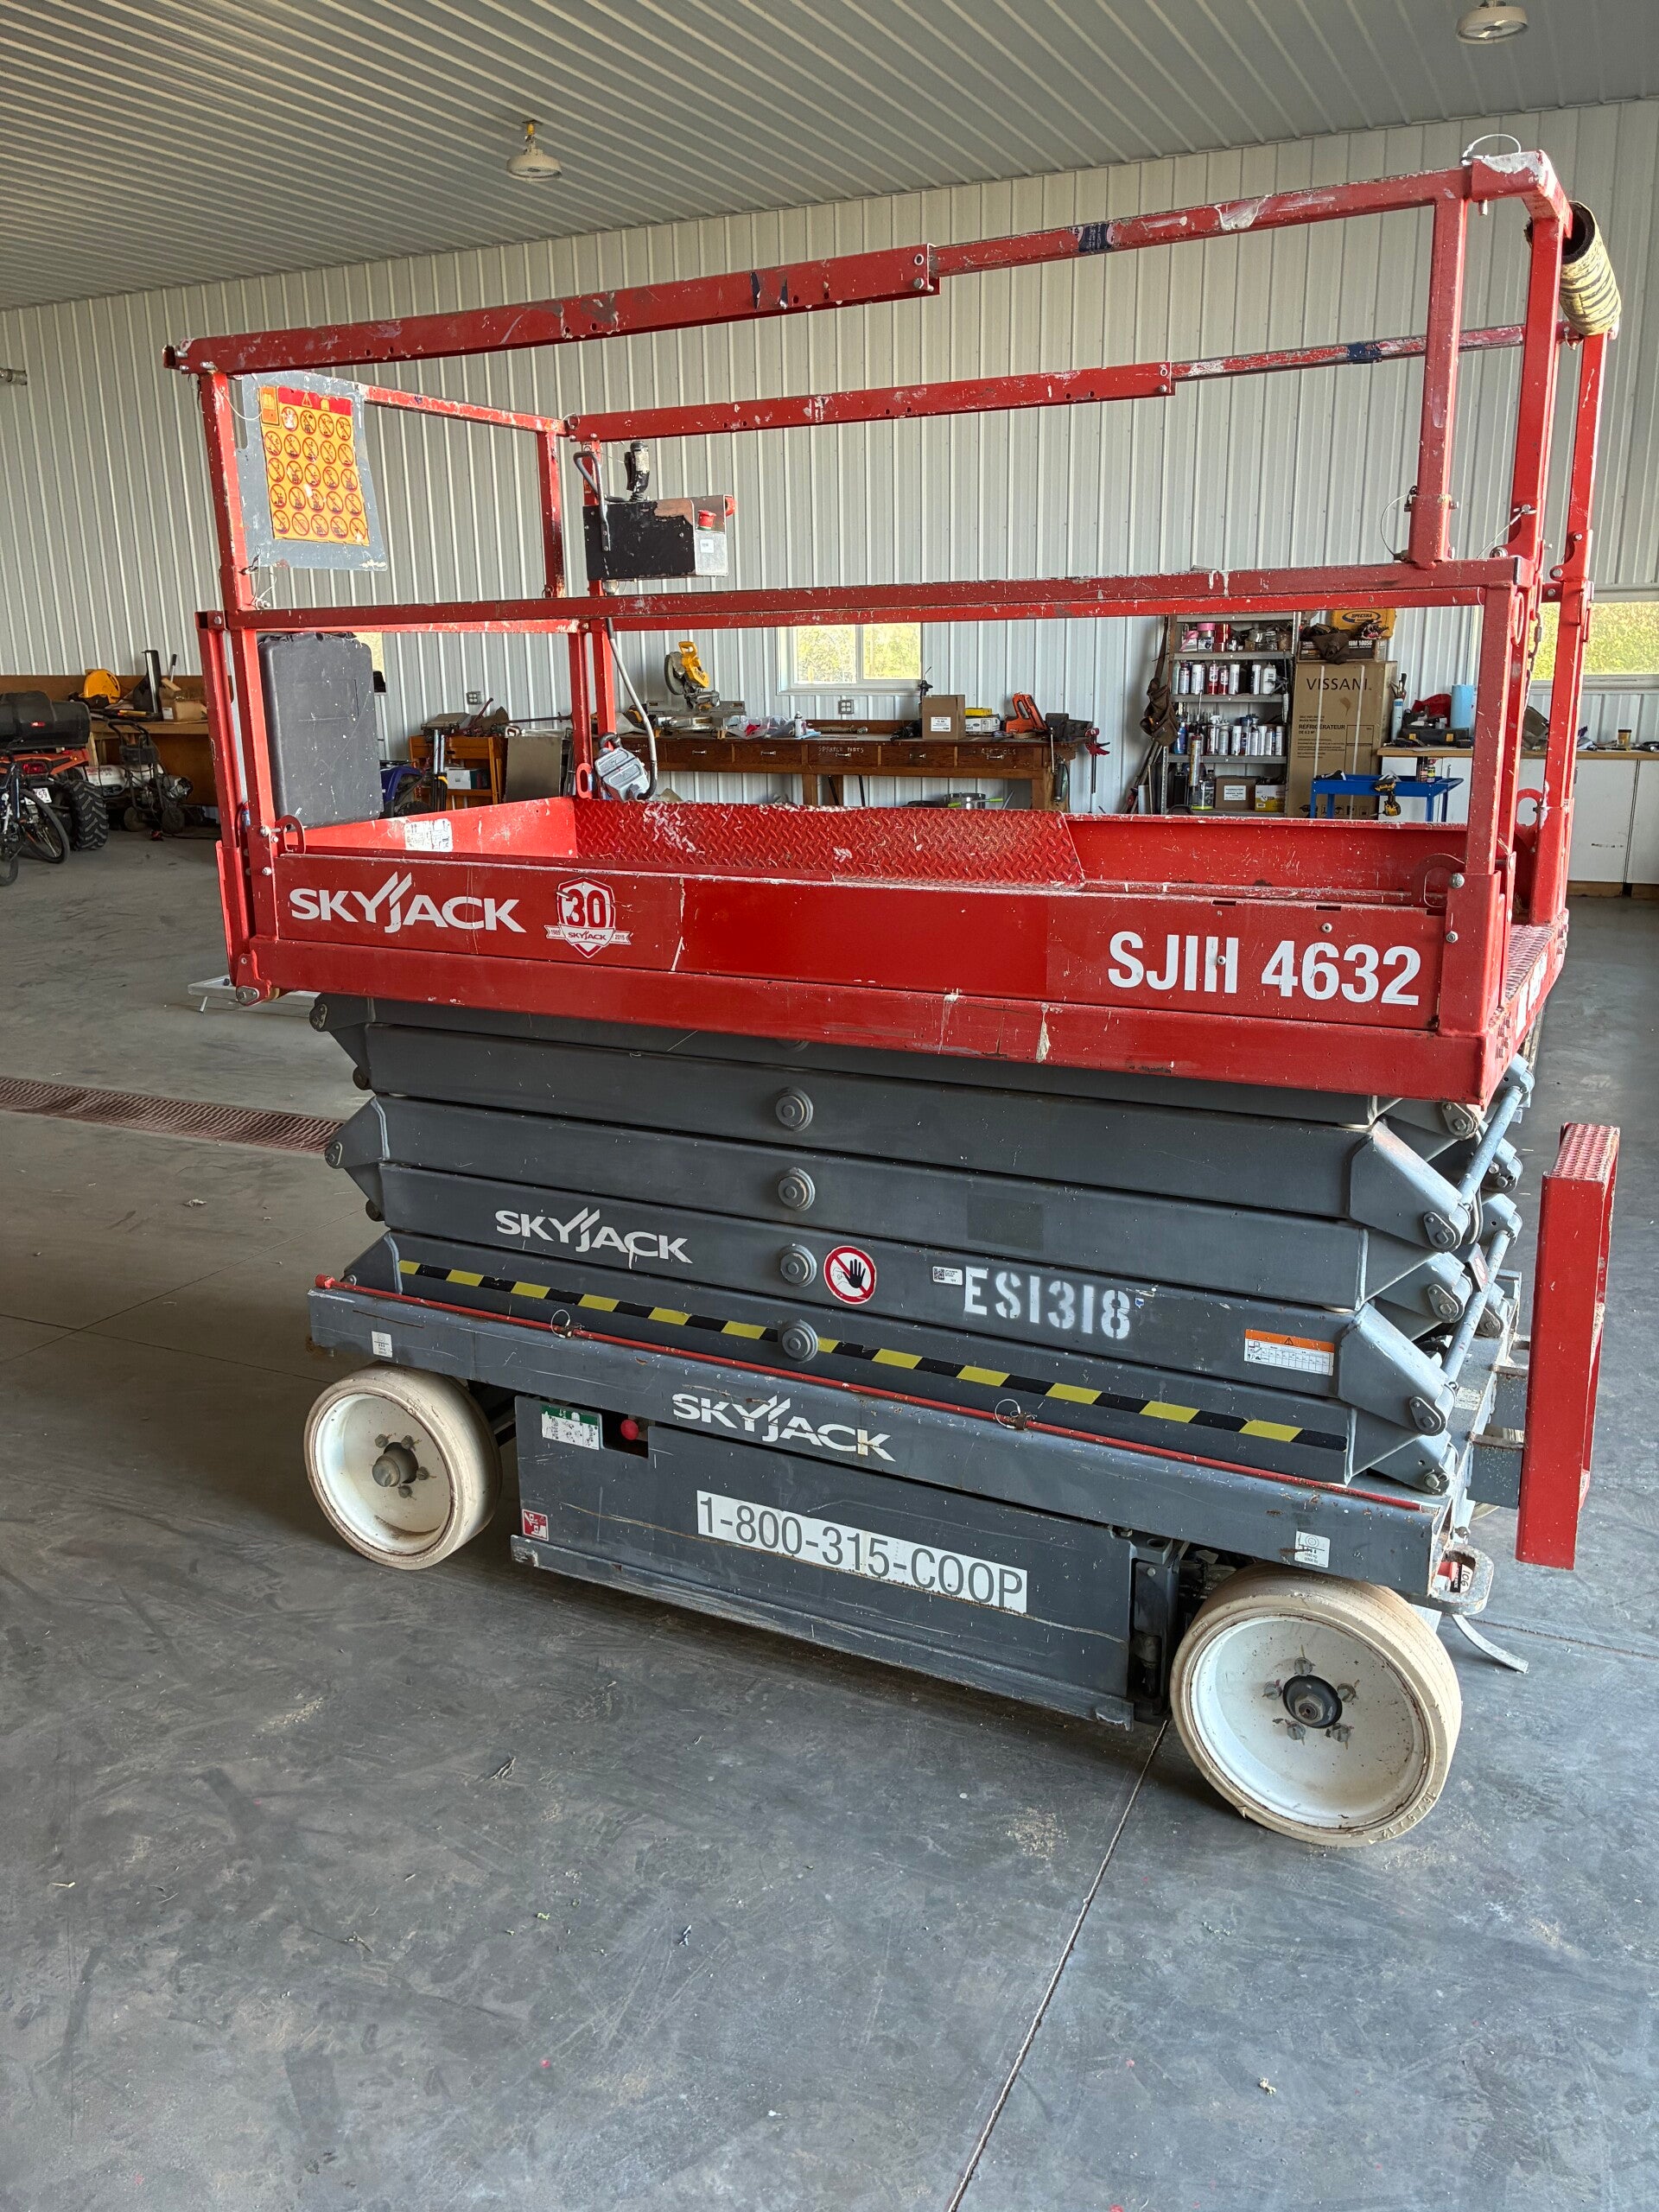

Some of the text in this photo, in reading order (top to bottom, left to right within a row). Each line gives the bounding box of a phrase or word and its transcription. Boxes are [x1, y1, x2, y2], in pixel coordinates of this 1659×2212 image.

[1306, 677, 1368, 690] VISSANI
[289, 871, 527, 934] SKYJACK
[564, 888, 607, 928] 30
[568, 930, 607, 941] SKYJACK
[1261, 939, 1421, 1006] 4632
[494, 1206, 693, 1264] SKYJACK
[964, 1266, 1130, 1339] ES1318
[671, 1395, 896, 1462] SKYJACK
[700, 1497, 1023, 1609] 1-800-315-COOP
